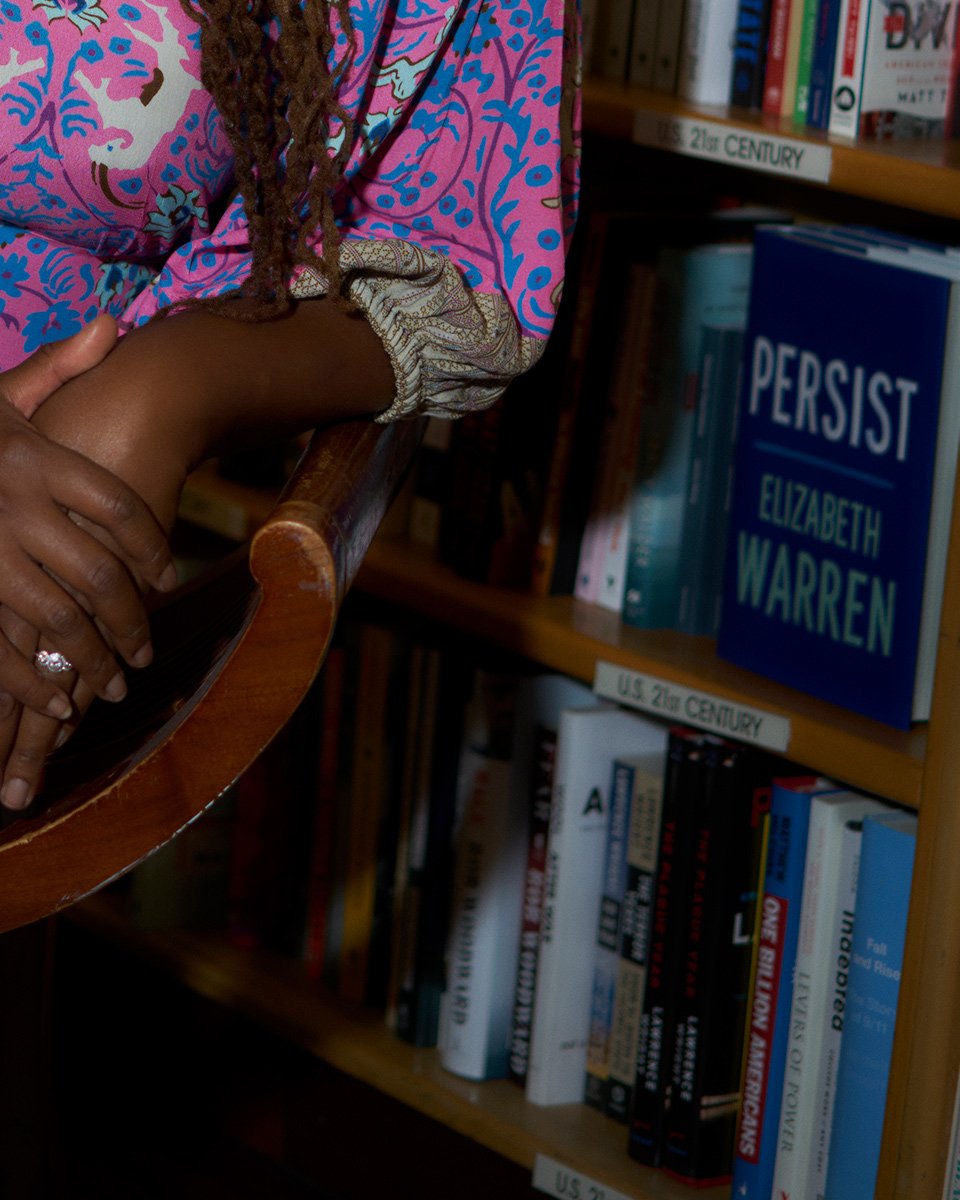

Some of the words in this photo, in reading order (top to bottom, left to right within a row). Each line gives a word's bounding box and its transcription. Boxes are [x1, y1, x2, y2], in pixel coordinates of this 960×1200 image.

[897, 88, 934, 104] MATT
[656, 120, 685, 146] U.S.
[724, 134, 805, 170] CENTURY
[749, 335, 919, 461] PERSIST
[758, 473, 883, 560] ELIZABETH
[738, 530, 897, 657] WARREN
[617, 673, 646, 700] U.S.
[685, 694, 764, 740] CENTURY
[661, 820, 676, 857] THE
[696, 828, 711, 864] THE
[777, 816, 792, 885] MATTHEW
[652, 861, 672, 936] PLAGUE
[688, 868, 707, 944] PLAGUE
[763, 897, 782, 944] ONE
[646, 940, 663, 990] YEAR
[683, 949, 699, 999] YEAR
[865, 938, 888, 957] Fall
[873, 960, 902, 981] Rise
[752, 946, 778, 1031] BILLION
[792, 970, 811, 1043] LEVERS
[644, 1005, 666, 1095] LAWRENCE
[679, 1015, 700, 1103] LAWRENCE
[788, 1047, 805, 1078] OF
[738, 1032, 768, 1158] AMERICANS
[780, 1082, 801, 1153] POWER
[555, 1170, 583, 1198] U.S.
